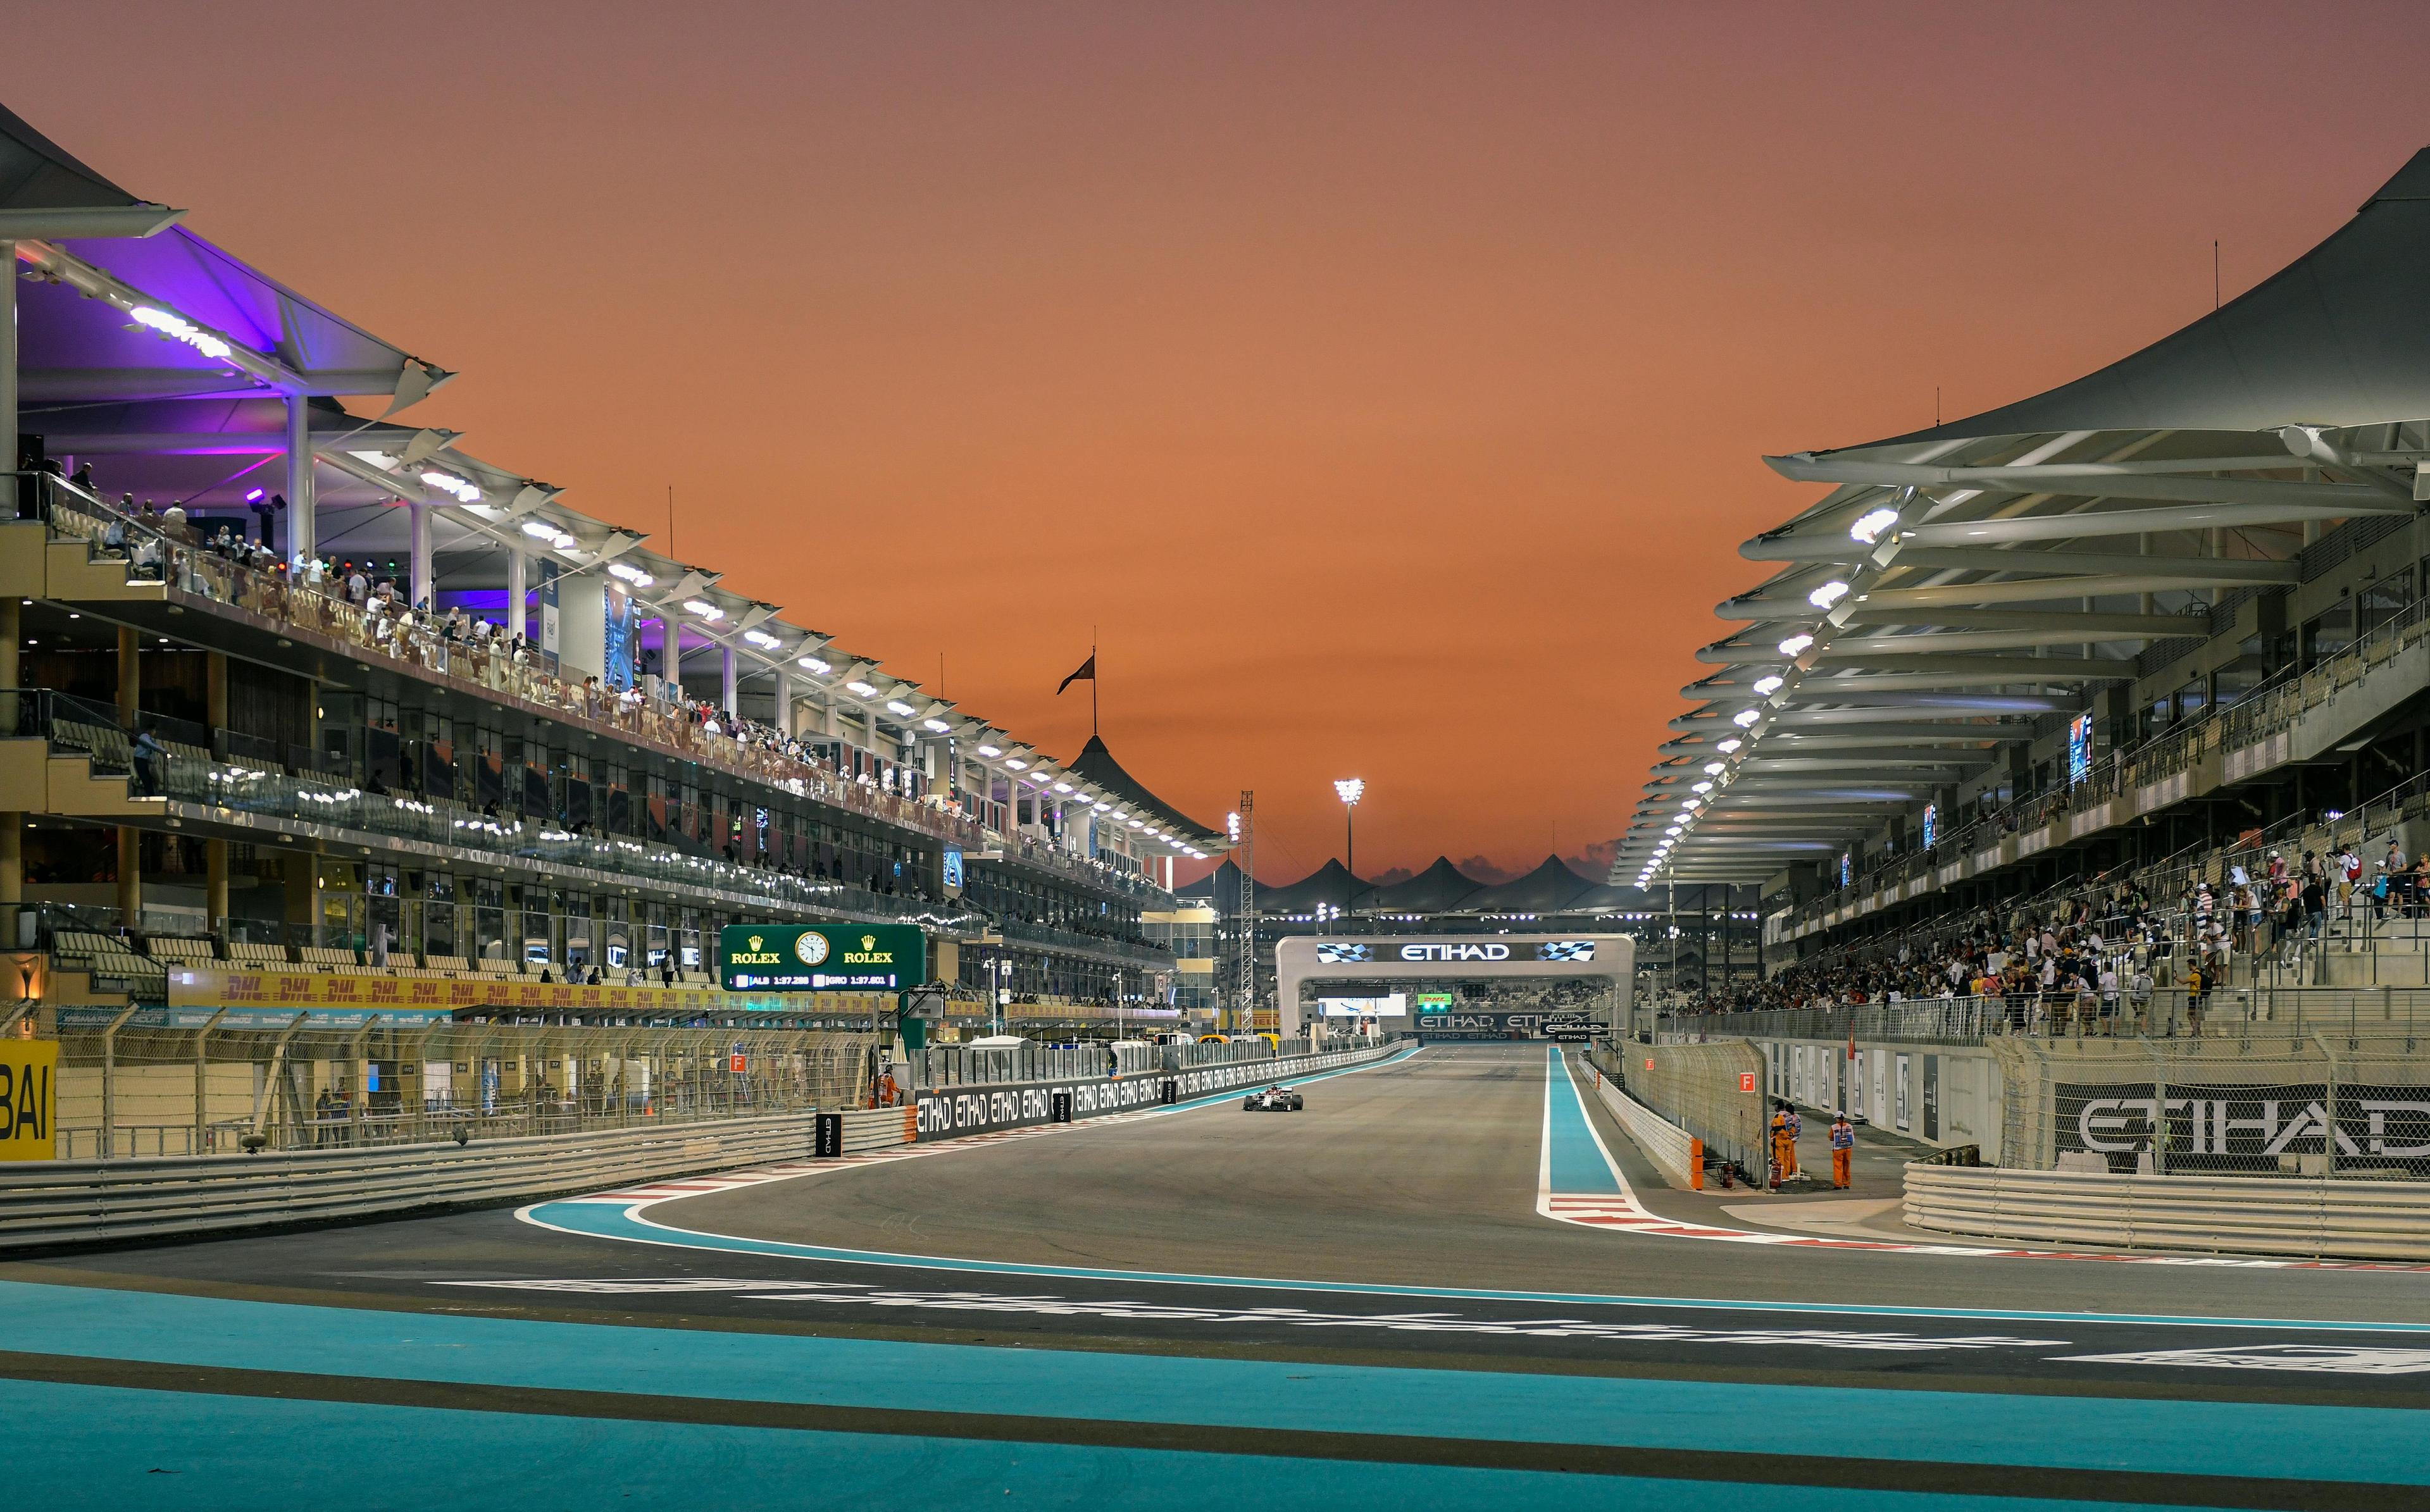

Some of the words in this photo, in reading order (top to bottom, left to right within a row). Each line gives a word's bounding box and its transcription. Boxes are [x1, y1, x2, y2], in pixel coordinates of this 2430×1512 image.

[732, 953, 780, 964] ROLEX
[844, 952, 893, 963] ROLEX
[1401, 943, 1510, 961] ETIHAD
[226, 976, 263, 1001] DHL
[280, 977, 312, 1002] DHL
[328, 979, 358, 1003] DHL
[372, 981, 399, 1003] DHL
[413, 982, 439, 1004] DHL
[451, 984, 475, 1005] DHL
[487, 985, 509, 1005] DHL
[521, 986, 542, 1006] DHL
[552, 988, 573, 1007] DHL
[582, 989, 601, 1007] DHL
[611, 990, 628, 1008] DHL
[637, 991, 654, 1009] DHL
[662, 992, 678, 1009] DHL
[1421, 1015, 1494, 1028] ETIHAD
[735, 1057, 742, 1069] F
[1648, 1060, 1653, 1069] F
[1188, 1072, 1200, 1093] ETIHAD
[1202, 1070, 1213, 1090] ETIHAD
[1214, 1069, 1225, 1088] ETIHAD
[1226, 1067, 1236, 1086] ETIHAD
[1743, 1075, 1751, 1089] F
[1077, 1084, 1097, 1112] ETIHAD
[1100, 1082, 1119, 1108] ETIHAD
[1121, 1081, 1137, 1105] ETIHAD
[1140, 1077, 1155, 1102] ETIHAD
[956, 1093, 987, 1127] ETIHAD
[991, 1091, 1018, 1123] ETIHAD
[1023, 1088, 1047, 1119] ETIHAD
[917, 1096, 951, 1132] ETIHAD
[2079, 1098, 2430, 1157] ETIHAD
[732, 1294, 1328, 1322] ENERGY
[1287, 1320, 1619, 1337] FOR
[1598, 1333, 1993, 1351] LIFE
[2096, 1356, 2379, 1370] ADNOC
